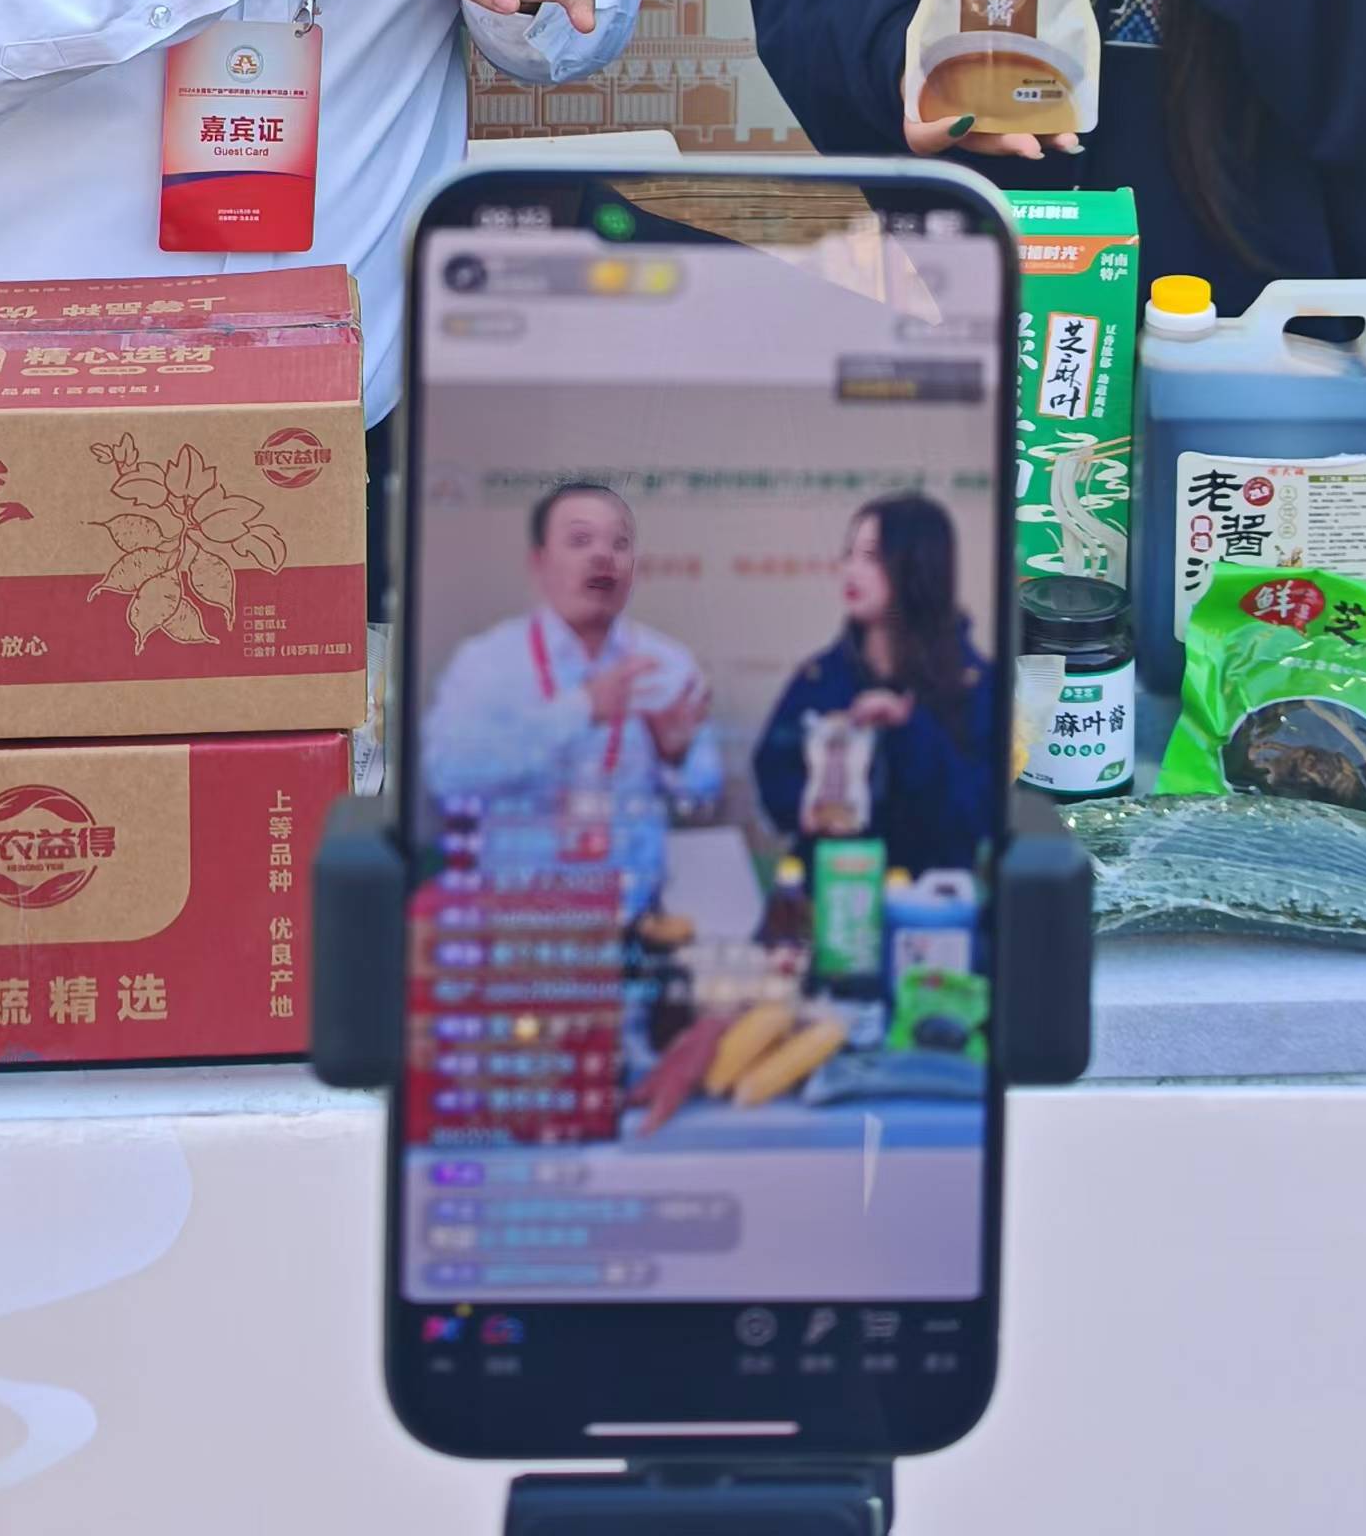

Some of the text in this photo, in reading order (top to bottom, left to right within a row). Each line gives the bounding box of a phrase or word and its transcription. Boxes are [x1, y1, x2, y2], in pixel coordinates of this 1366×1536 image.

[199, 115, 285, 143] 嘉宾证
[213, 146, 270, 158] Guest Card
[24, 344, 215, 365] 精心选材
[1053, 704, 1127, 738] 麻叶酱
[269, 790, 294, 1019] 上等品种 优良产地
